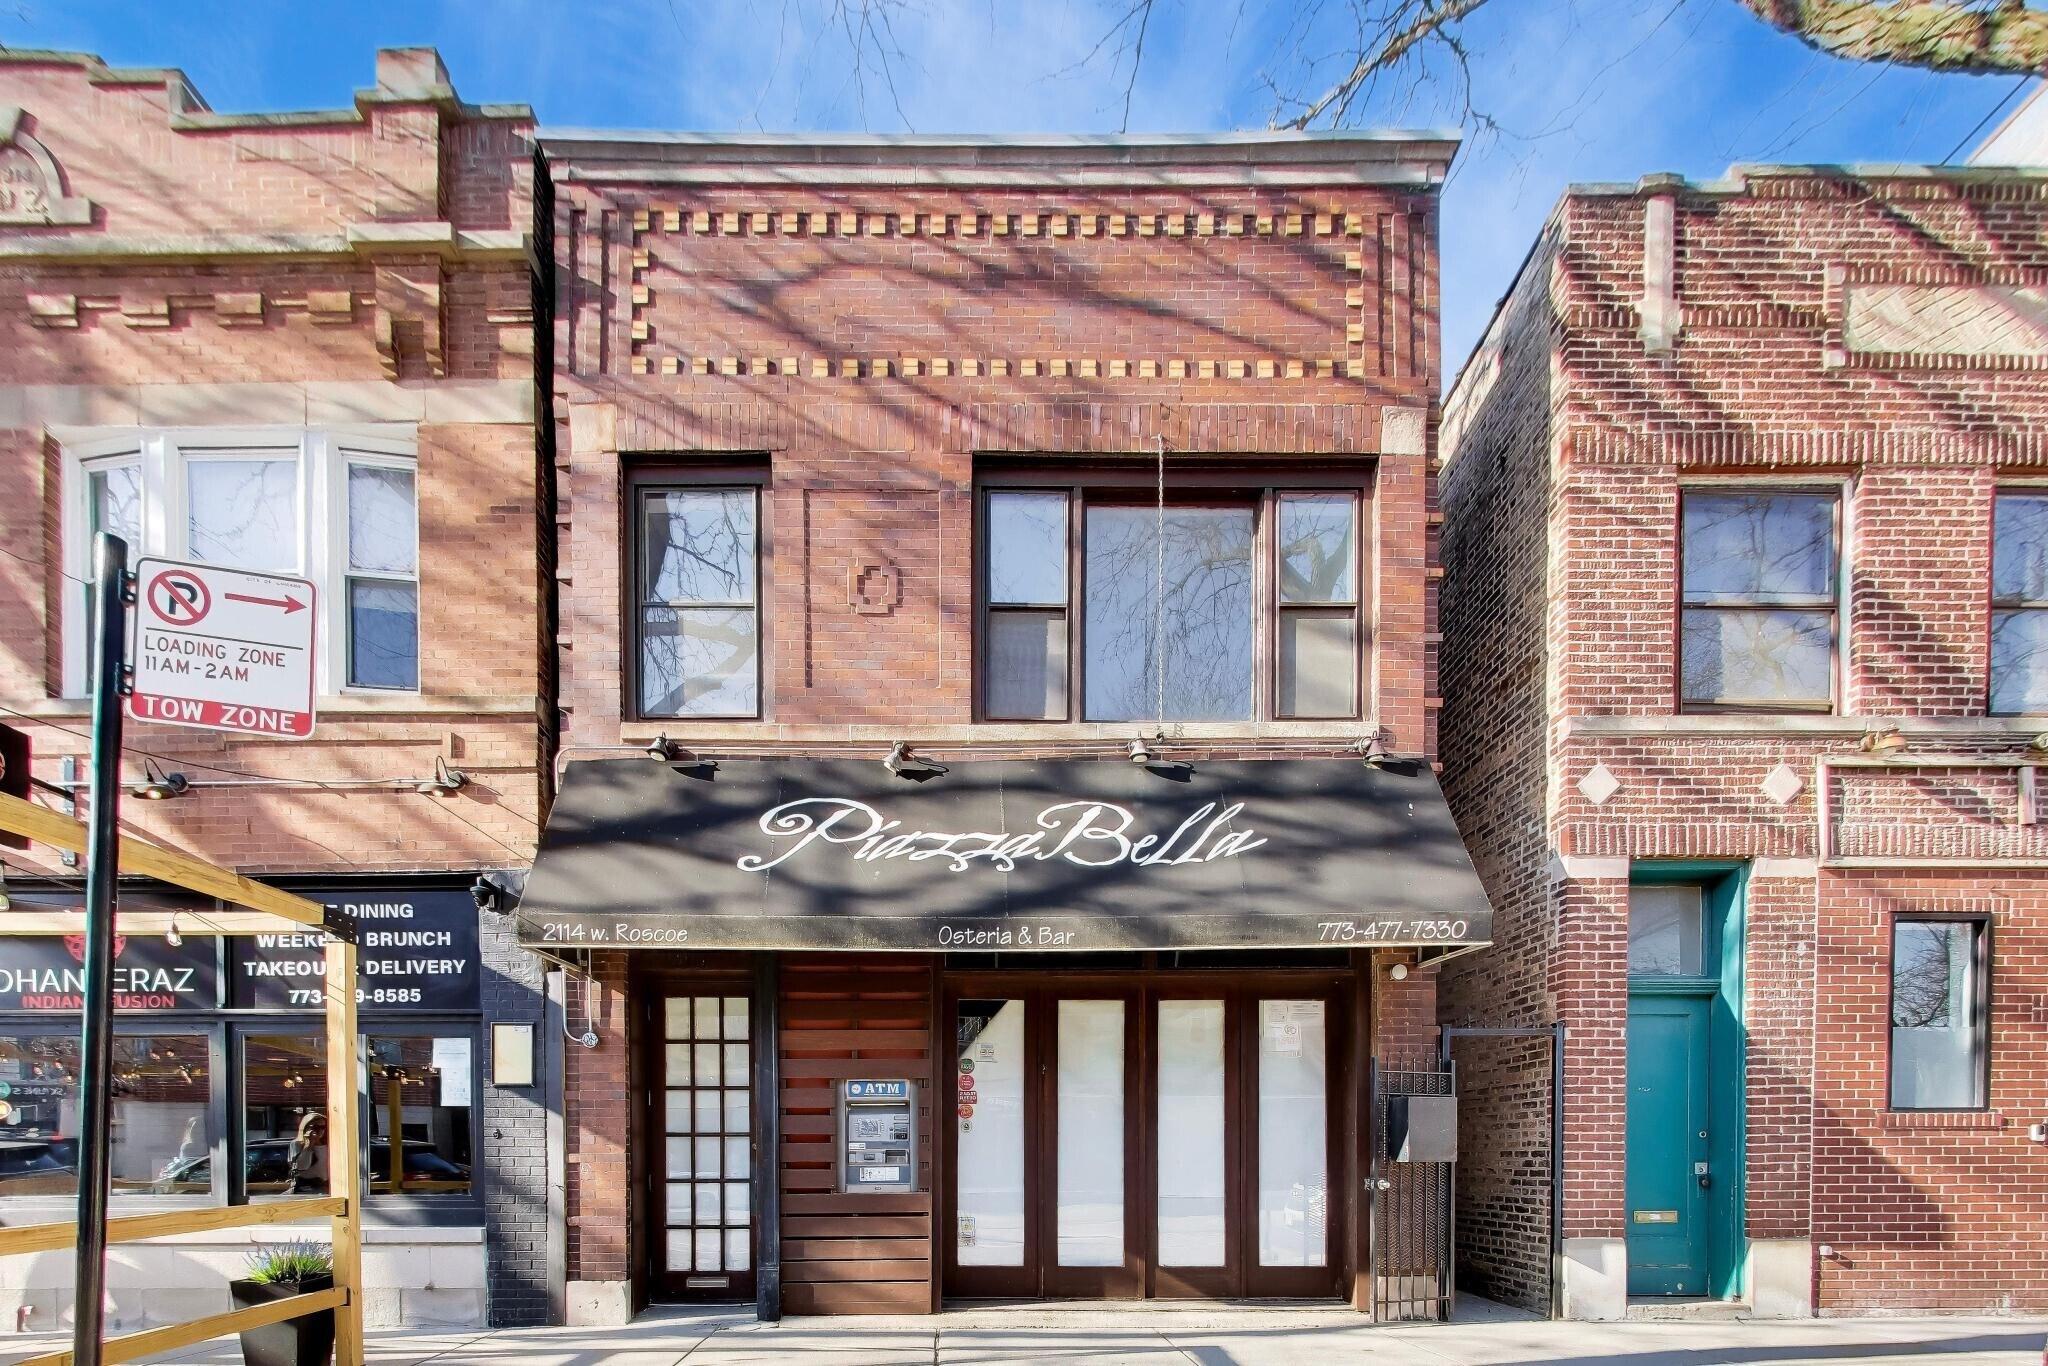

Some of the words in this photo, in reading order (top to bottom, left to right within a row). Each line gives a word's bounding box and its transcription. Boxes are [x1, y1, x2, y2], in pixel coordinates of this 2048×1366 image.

[145, 635, 226, 659] LOADING
[238, 647, 286, 668] ZONE
[145, 655, 249, 682] 11AM-2AM
[142, 695, 203, 721] TOW
[219, 705, 296, 733] ZONE
[737, 798, 1046, 872] Piazza
[1034, 801, 1268, 866] Bella
[257, 931, 360, 948] WEEKE
[366, 931, 451, 947] BRUNCH
[543, 923, 586, 941] 2114
[615, 923, 688, 942] Roscoe
[938, 925, 1012, 945] Osteria
[1018, 926, 1033, 945] &
[1038, 926, 1076, 945] Bar
[1317, 920, 1468, 941] 773-477-7330
[243, 960, 328, 976] TAKEOU
[366, 959, 467, 976] DELIVERY
[865, 1083, 900, 1094] ATM
